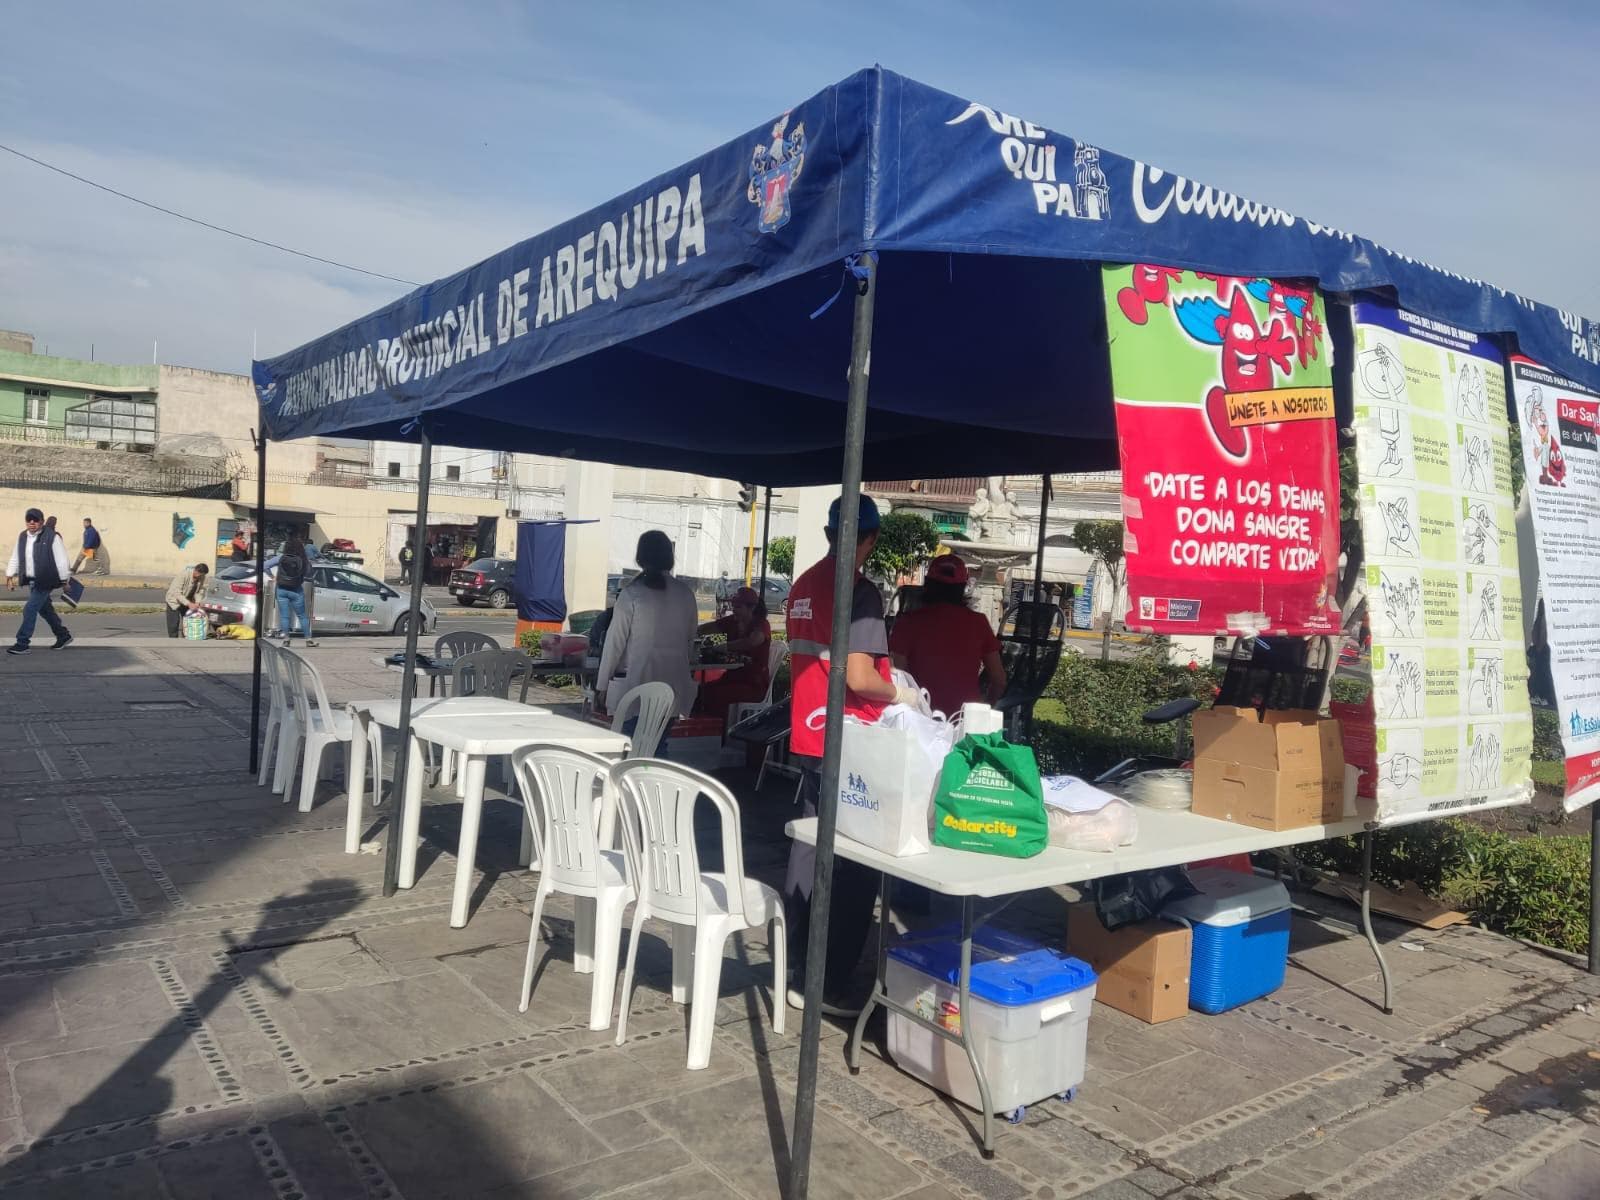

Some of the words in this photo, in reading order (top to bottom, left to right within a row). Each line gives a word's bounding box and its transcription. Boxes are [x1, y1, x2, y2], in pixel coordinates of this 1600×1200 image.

[1001, 137, 1056, 181] QUI
[1033, 182, 1077, 218] PA
[278, 344, 377, 416] MUNICIPALIDAD
[377, 292, 491, 390] PROVINCIAL
[497, 268, 530, 346] DE
[535, 173, 706, 329] AREQUIPA
[1229, 397, 1267, 420] ÚNETE
[1271, 400, 1279, 415] A
[1283, 397, 1328, 414] NOSOTROS
[1561, 403, 1577, 418] Dar
[1562, 430, 1571, 440] es
[1572, 430, 1583, 442] dar
[1215, 477, 1228, 501] A
[1236, 478, 1272, 507] LOS
[1176, 506, 1235, 534] DONA
[1170, 539, 1271, 570] COMPARTE
[349, 602, 374, 613] texas
[841, 790, 880, 811] EsSalud
